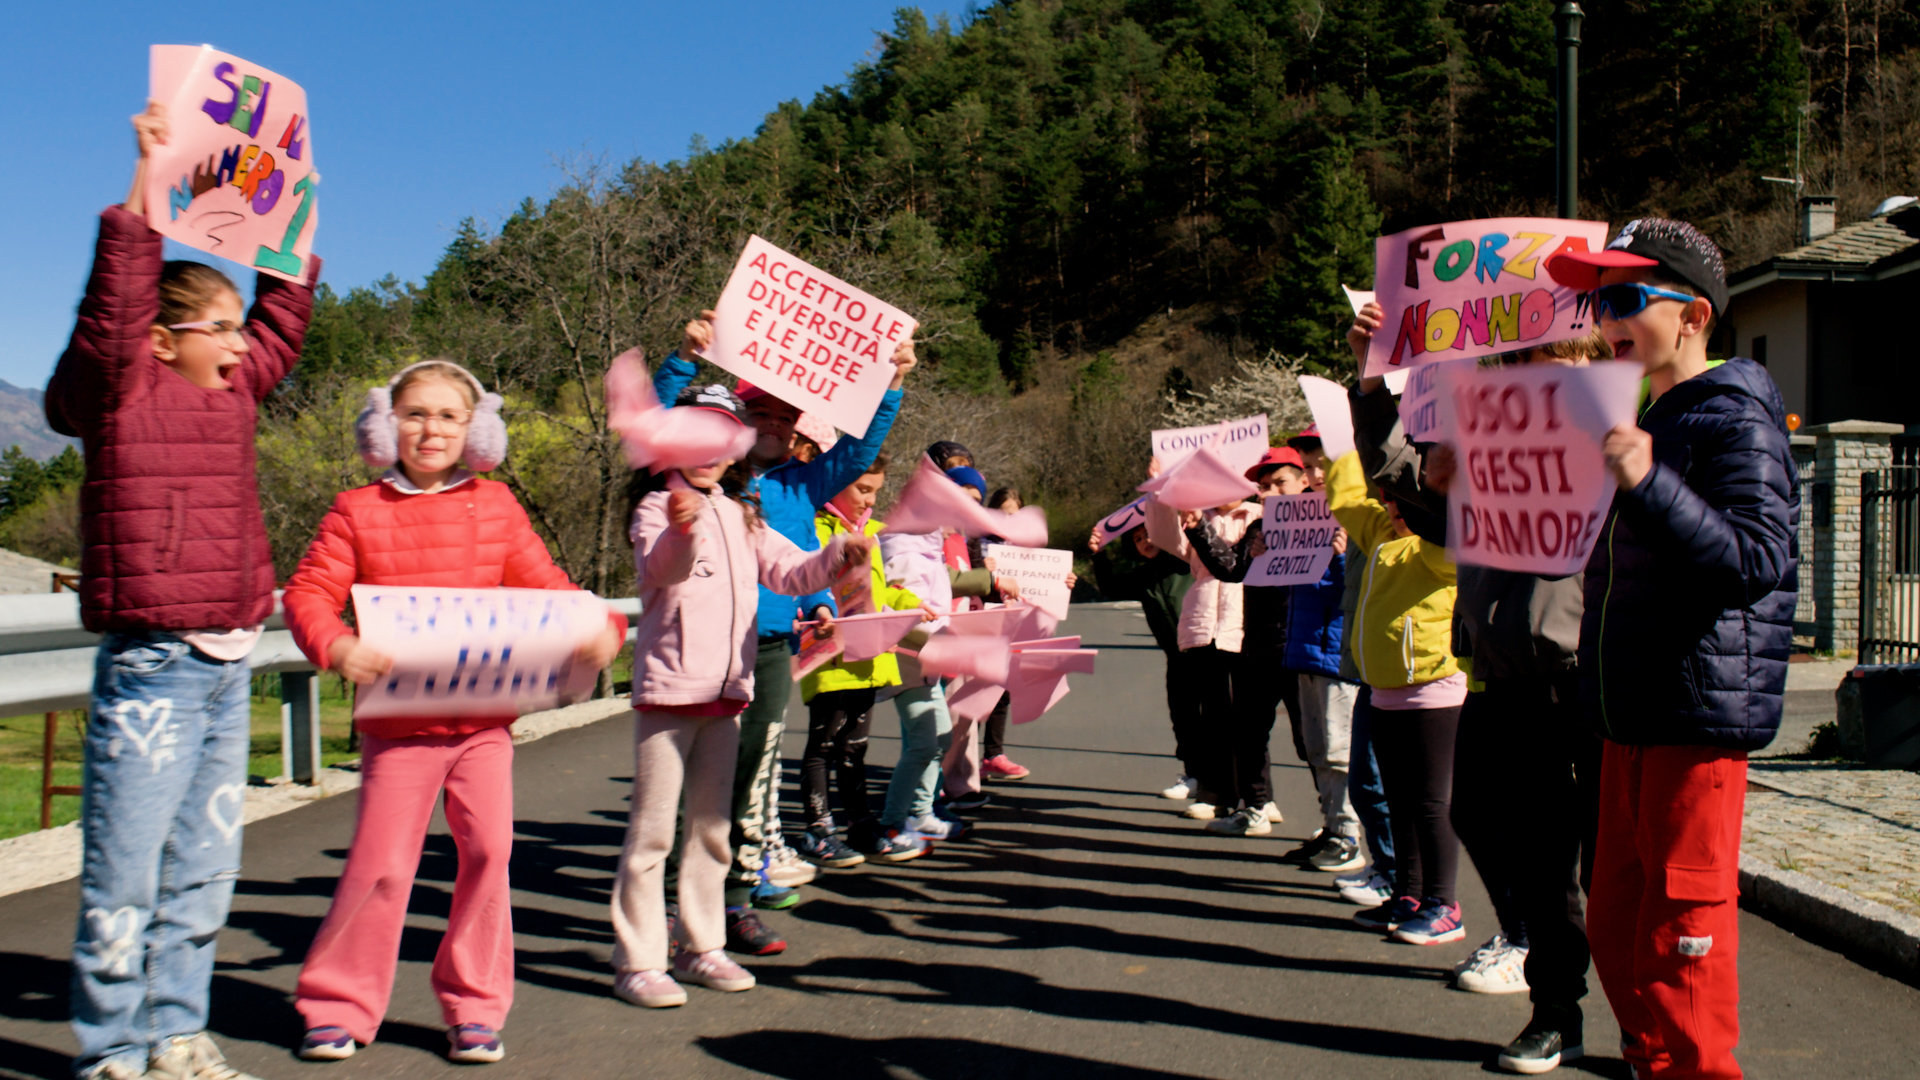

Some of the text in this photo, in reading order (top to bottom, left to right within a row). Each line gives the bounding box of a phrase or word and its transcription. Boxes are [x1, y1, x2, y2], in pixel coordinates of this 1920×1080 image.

[202, 61, 270, 138] SEI
[168, 144, 315, 277] NUMERO 1
[747, 280, 883, 363] DIVERSITÀ
[748, 252, 904, 342] ACCETTO LE
[744, 310, 863, 383] E LE IDEE
[1388, 288, 1555, 366] NONNO
[739, 341, 840, 402] ALTRUI
[1456, 380, 1563, 435] USO I
[1468, 445, 1573, 495] GESTI
[1275, 499, 1332, 523] CONSOLO
[1460, 503, 1600, 558] D'AMORE
[1000, 551, 1061, 563] MI METTO
[1264, 529, 1290, 550] CON
[1266, 554, 1317, 575] GENTILI
[997, 568, 1061, 580] NEI PANNI
[1020, 587, 1049, 597] EGLI
